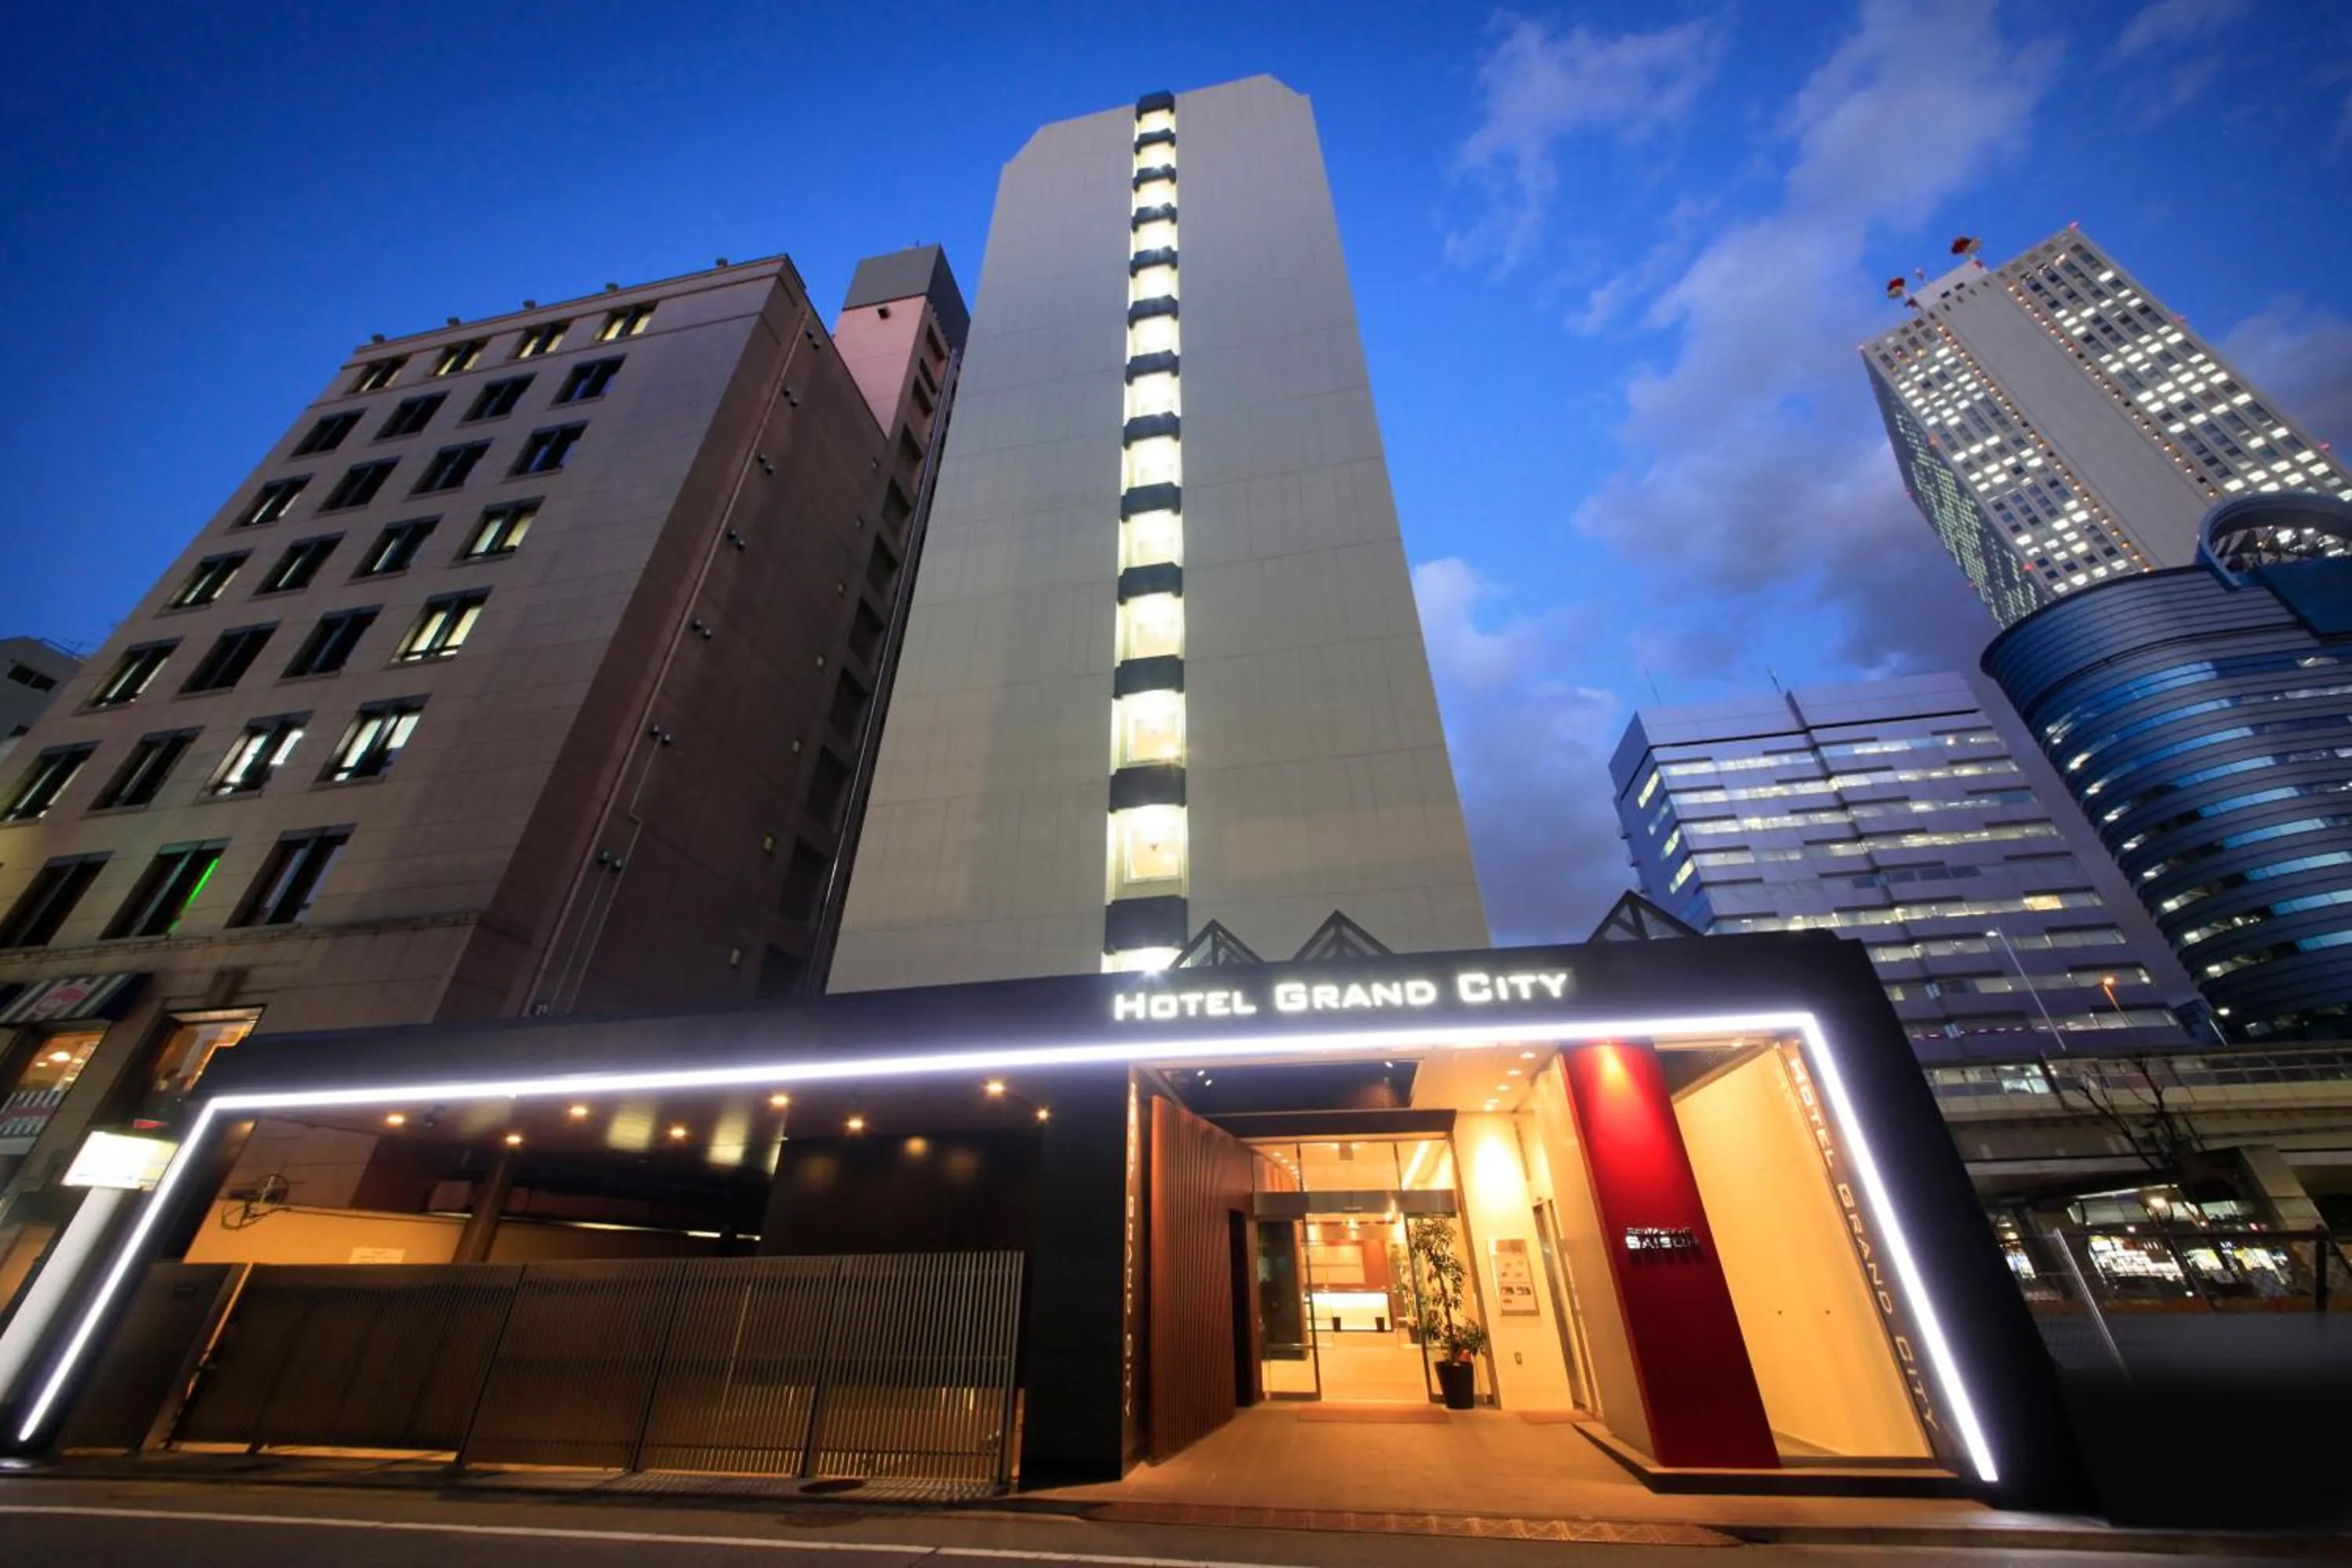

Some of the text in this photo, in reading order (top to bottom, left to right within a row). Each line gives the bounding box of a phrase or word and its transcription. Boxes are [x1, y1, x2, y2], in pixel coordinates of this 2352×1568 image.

[1113, 972, 1568, 1021] HOTEL GRAND CITY
[1788, 1057, 1939, 1431] HOTEL GRAND CITY
